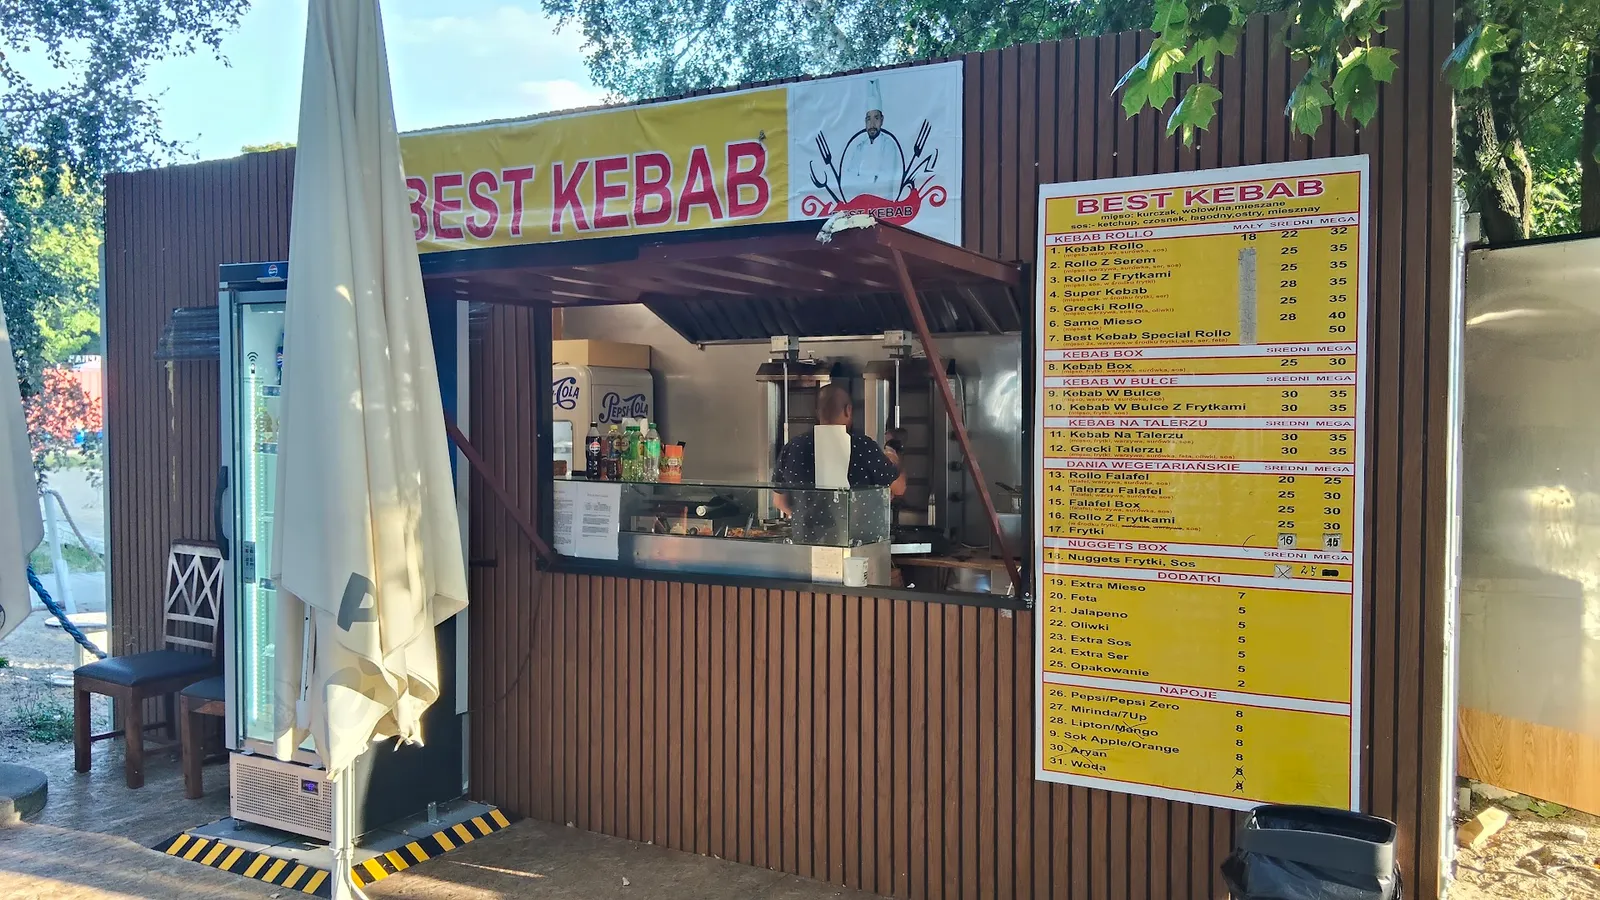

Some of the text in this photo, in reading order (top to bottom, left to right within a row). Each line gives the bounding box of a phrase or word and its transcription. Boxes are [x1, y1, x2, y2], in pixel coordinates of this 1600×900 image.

[406, 140, 771, 241] BEST KEBAB
[1077, 179, 1324, 215] BEST KEBAB
[869, 206, 912, 219] KEBAB
[1137, 209, 1179, 217] kurczak,
[1143, 216, 1187, 224] czosnek,
[1268, 206, 1321, 215] miesznay
[1055, 230, 1153, 243] KEBAB ROLLO
[1241, 233, 1256, 241] 18
[1331, 227, 1347, 235] 32
[1065, 242, 1143, 253] Kebab Rollo
[1281, 244, 1347, 255] 25 35
[1065, 260, 1097, 268] Rollo
[1281, 261, 1347, 271] 25 35
[1101, 273, 1109, 281] Z
[1114, 271, 1171, 281] Frytkami
[1280, 277, 1347, 288] 28 35
[1064, 287, 1147, 298] Super Kebab
[1280, 296, 1297, 304] 25
[1064, 304, 1104, 312] Grecki
[1280, 311, 1346, 321] 28 40
[1142, 330, 1190, 340] Special
[1063, 378, 1109, 386] KEBAB
[1131, 377, 1177, 385] BUŁCE
[1281, 390, 1298, 398] 30
[1186, 403, 1246, 412] Frytkami
[1143, 419, 1207, 427] TALERZU
[1135, 431, 1183, 439] Talerzu
[1281, 433, 1298, 441] 30
[1111, 462, 1240, 471] WEGETARIAŃSKIE
[1069, 485, 1114, 493] Talerzu
[1119, 487, 1161, 495] Falafel
[1324, 492, 1341, 500] 30
[1049, 498, 1065, 506] 15.
[1069, 499, 1110, 507] Falafel
[1278, 505, 1341, 515] 25 30
[1069, 513, 1101, 521] Rollo
[1118, 515, 1175, 524] Frytkami
[1278, 520, 1340, 530] 25 30
[1069, 527, 1104, 535] Frytki
[1068, 540, 1167, 551] NUGGETS BOX
[1068, 553, 1120, 563] Nuggets
[1125, 557, 1166, 567] Frytki,
[1170, 559, 1196, 567] Sos
[1158, 572, 1220, 583] DODATKI
[1071, 580, 1103, 589] Extra
[1108, 583, 1146, 591] Mieso
[1050, 592, 1097, 602] 20. Feta
[1050, 605, 1128, 618] 21. Jalapeno
[1050, 619, 1109, 631] 22. Oliwki
[1050, 633, 1131, 646] 23. Extra Sos
[1050, 646, 1129, 660] 24. Extra Ser
[1050, 660, 1149, 676] 25. Opakowanie
[1160, 686, 1217, 699] NAPOJE
[1050, 689, 1179, 710] 26. Pepsi/Pepsi Zero
[1050, 703, 1147, 722] 27. Mirinda/7Up
[1050, 716, 1158, 737] 28. Lipton/Mango
[1064, 732, 1179, 754] Sok Apple/Orange
[1050, 743, 1107, 757] 30. Aryan
[1050, 757, 1106, 771] 31. Woda
